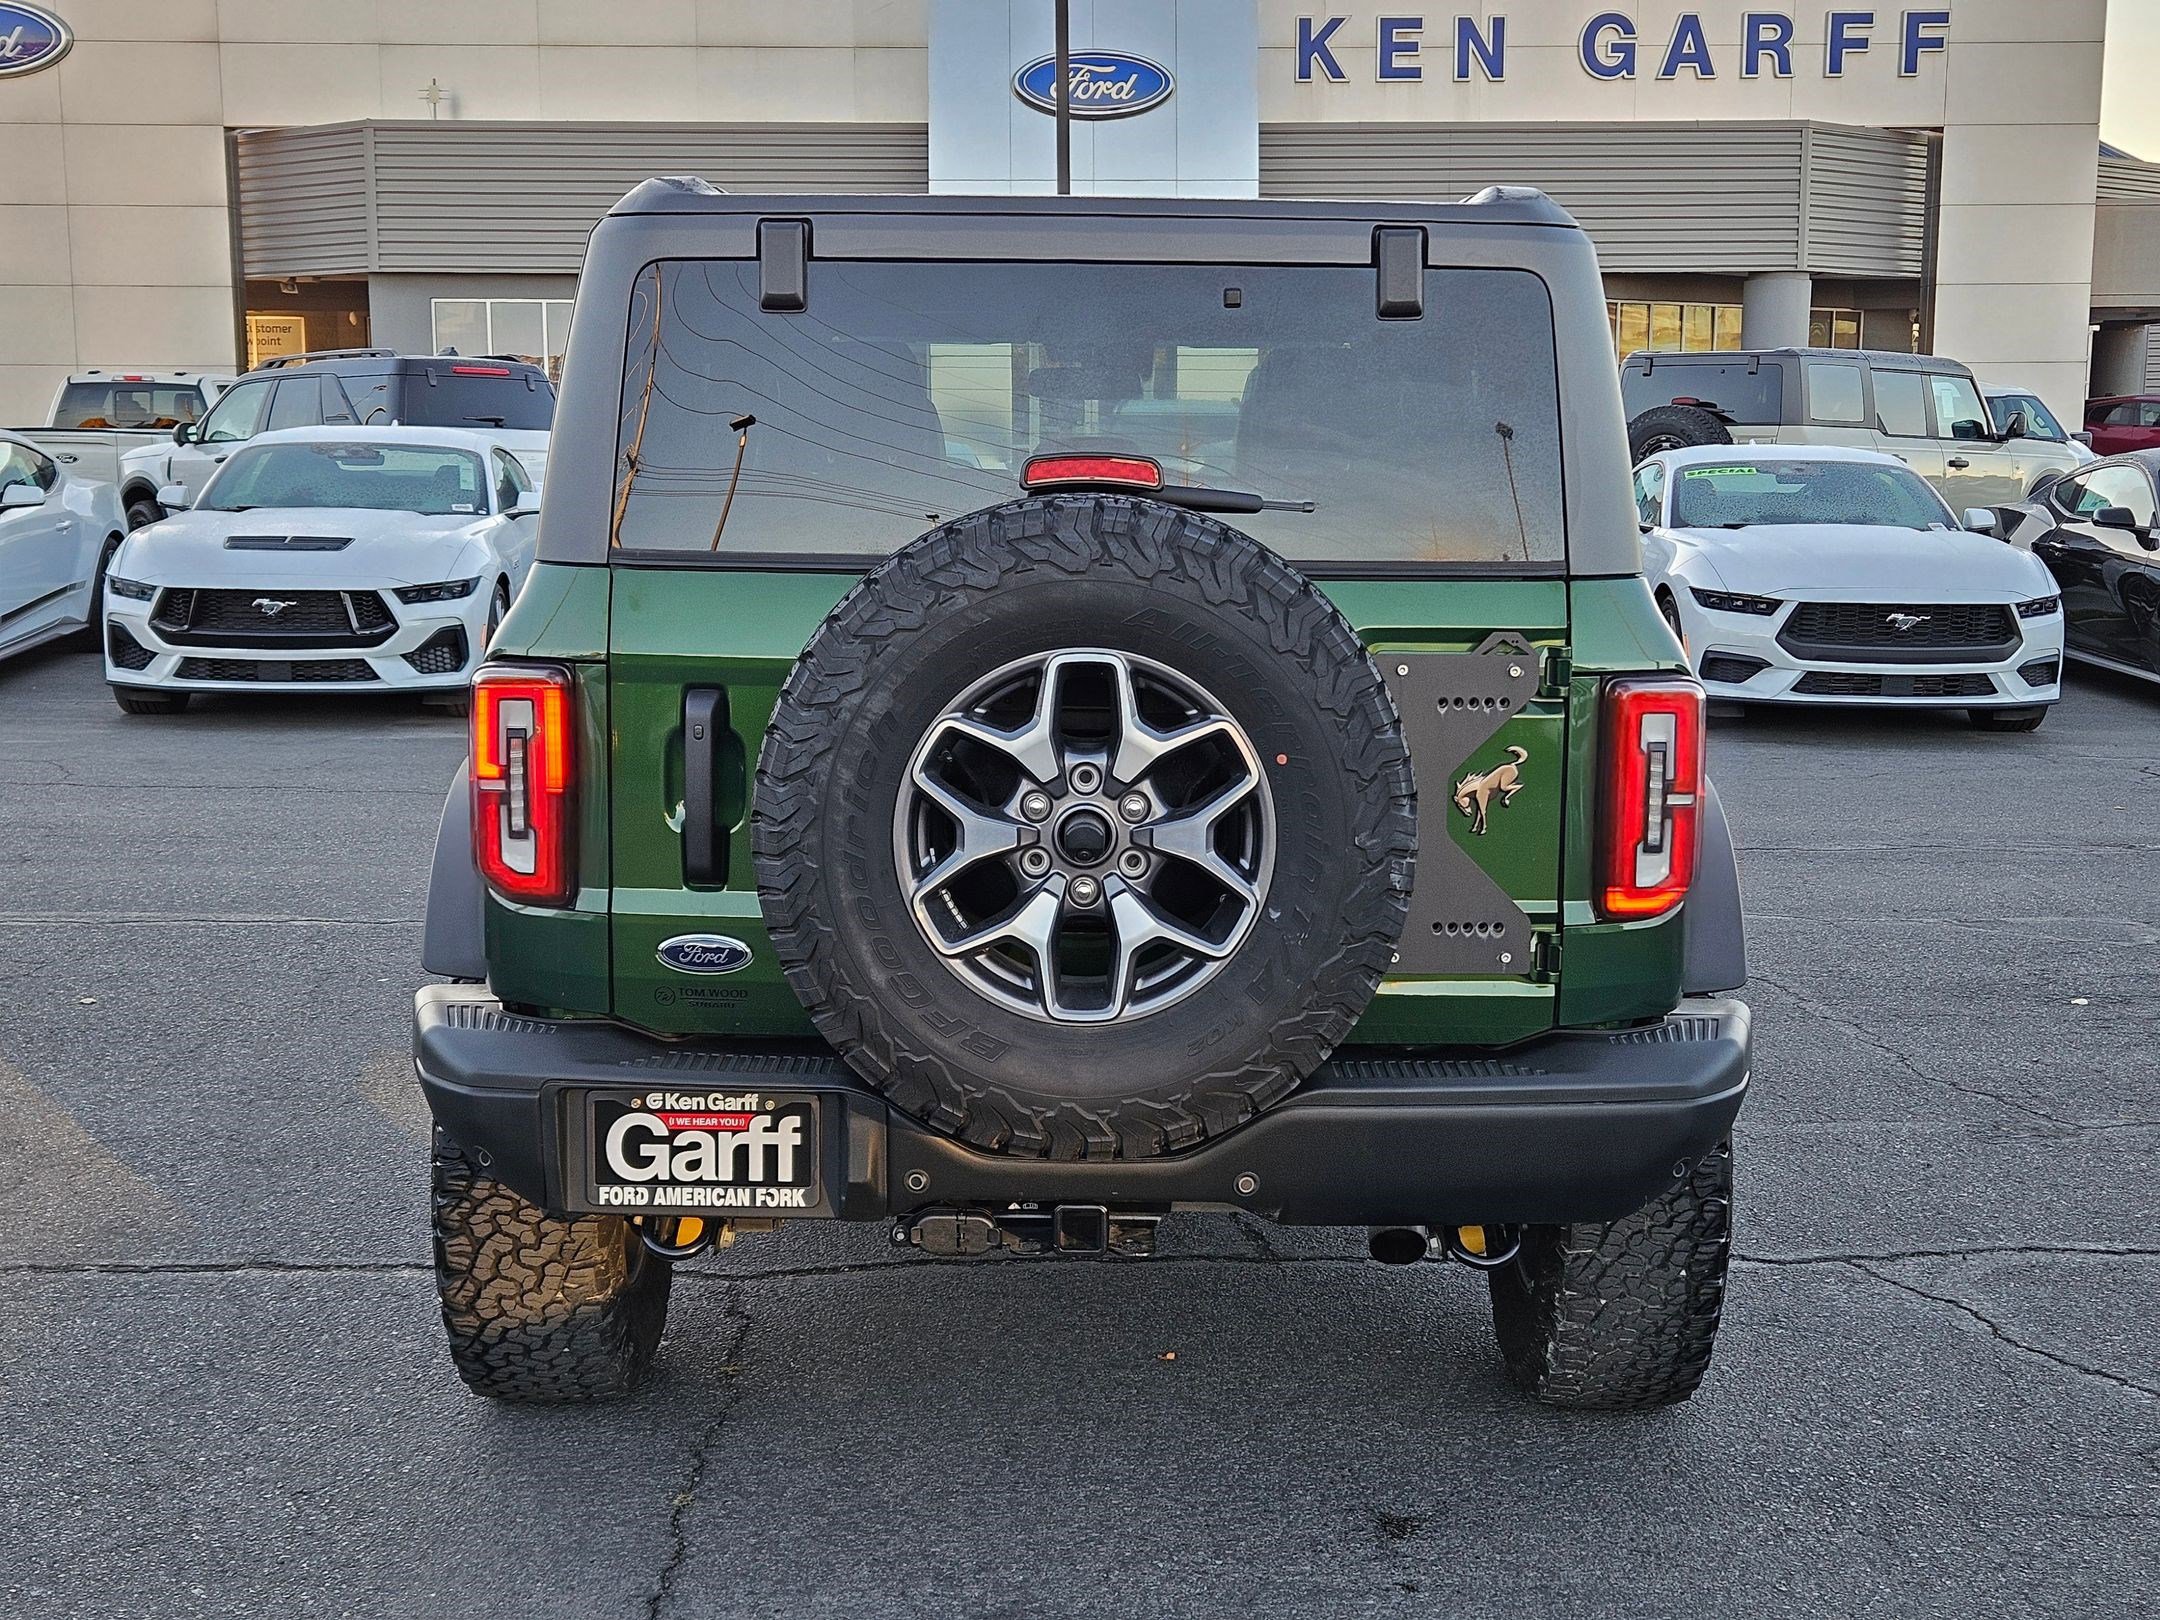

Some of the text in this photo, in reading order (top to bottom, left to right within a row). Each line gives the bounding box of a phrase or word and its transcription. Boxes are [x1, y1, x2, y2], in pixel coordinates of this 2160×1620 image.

[1295, 10, 1952, 83] KEN GARFF
[1049, 63, 1138, 101] Ford
[246, 324, 292, 334] ustomer
[678, 942, 730, 964] Ford
[680, 987, 748, 998] TOM WOOD
[687, 1000, 736, 1009] SUBARU
[665, 1092, 759, 1111] Ken Garff
[675, 1117, 738, 1127] WE HEAR YOU
[605, 1112, 802, 1183] Garff
[599, 1186, 806, 1208] FORD AMERICAN FORK
